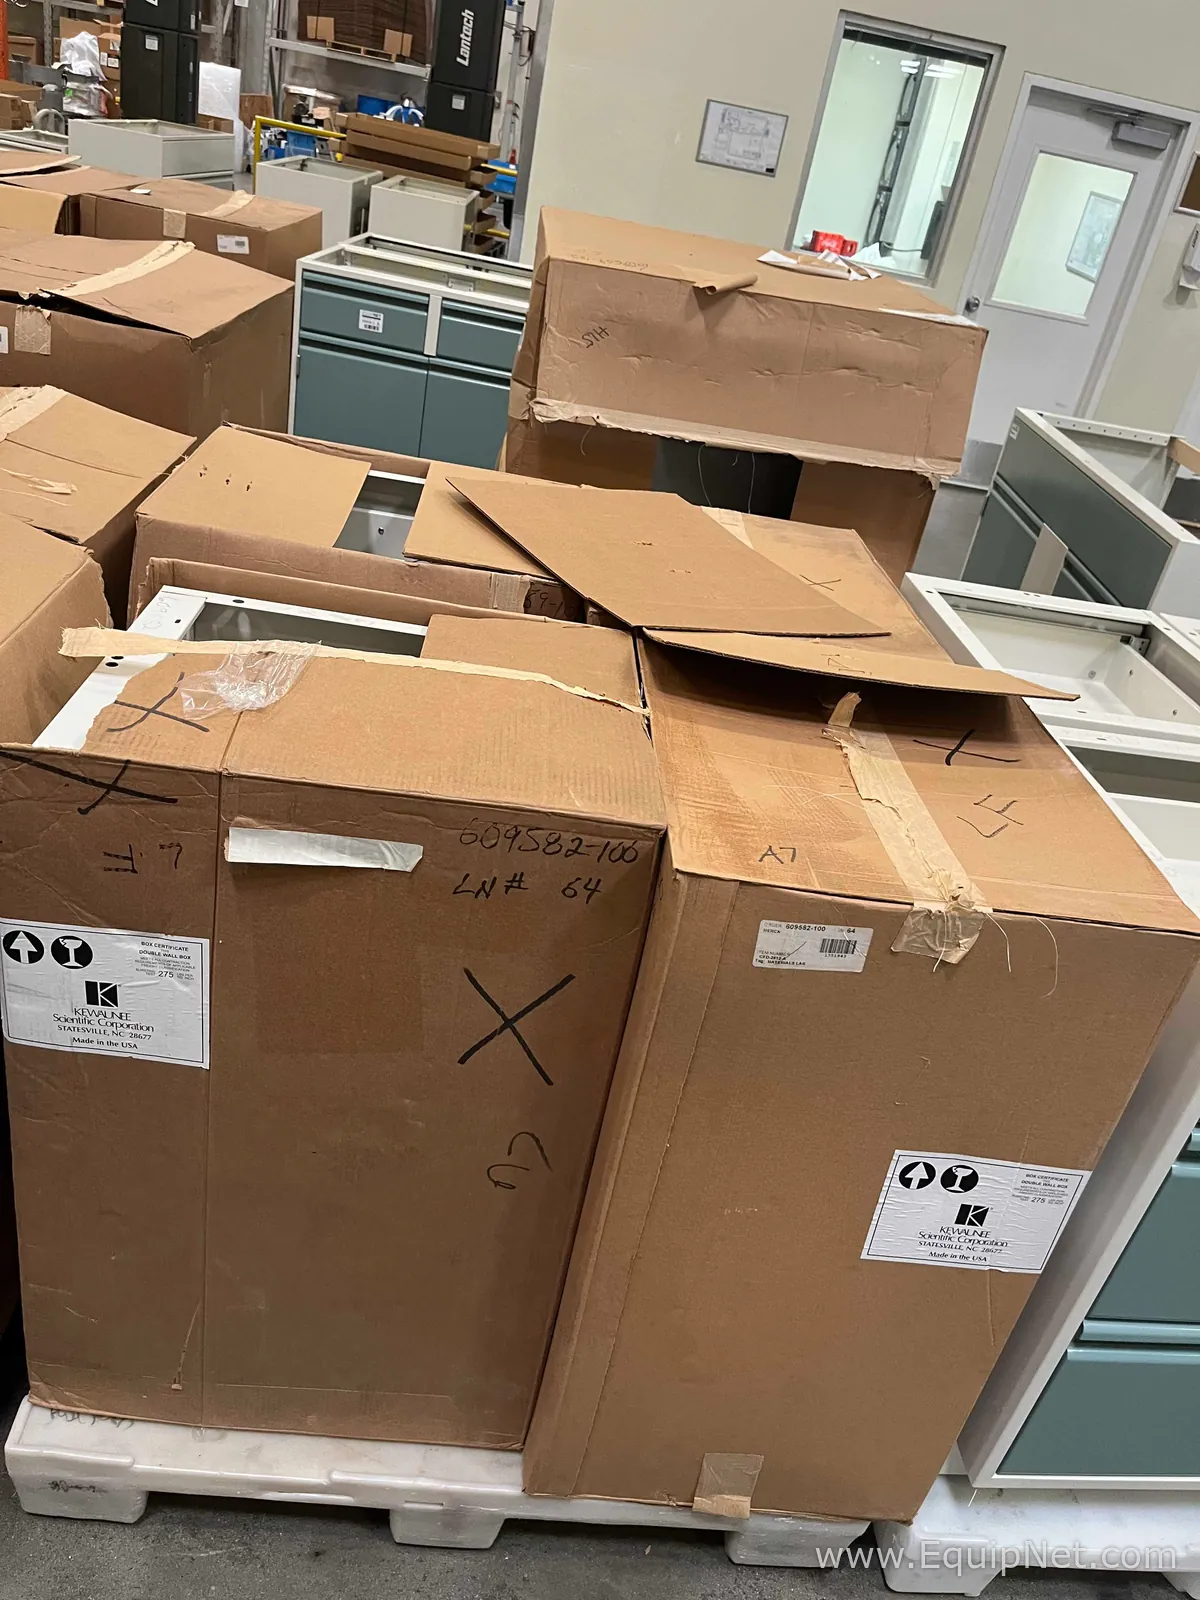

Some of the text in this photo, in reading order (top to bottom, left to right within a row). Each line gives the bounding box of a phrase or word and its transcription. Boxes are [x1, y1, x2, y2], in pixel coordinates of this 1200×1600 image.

[456, 8, 475, 67] Lantech
[458, 817, 640, 864] 609582-100
[561, 876, 603, 905] 64
[785, 923, 826, 933] 609582-100
[138, 949, 162, 957] DOUBLE
[153, 943, 189, 952] CERTIFICATE
[158, 970, 174, 978] 275
[73, 1007, 132, 1021] KEWAUNEE
[52, 1013, 155, 1032] Scientific Corporation
[57, 1024, 152, 1041] STATESVILLE, NC 28677
[72, 1036, 138, 1050] Made in the USA
[1030, 1196, 1046, 1204] 275
[918, 1231, 1008, 1248] Scientific Corporation
[939, 1226, 991, 1239] KEWAUNEE
[928, 1251, 949, 1259] Made
[959, 1253, 971, 1261] the
